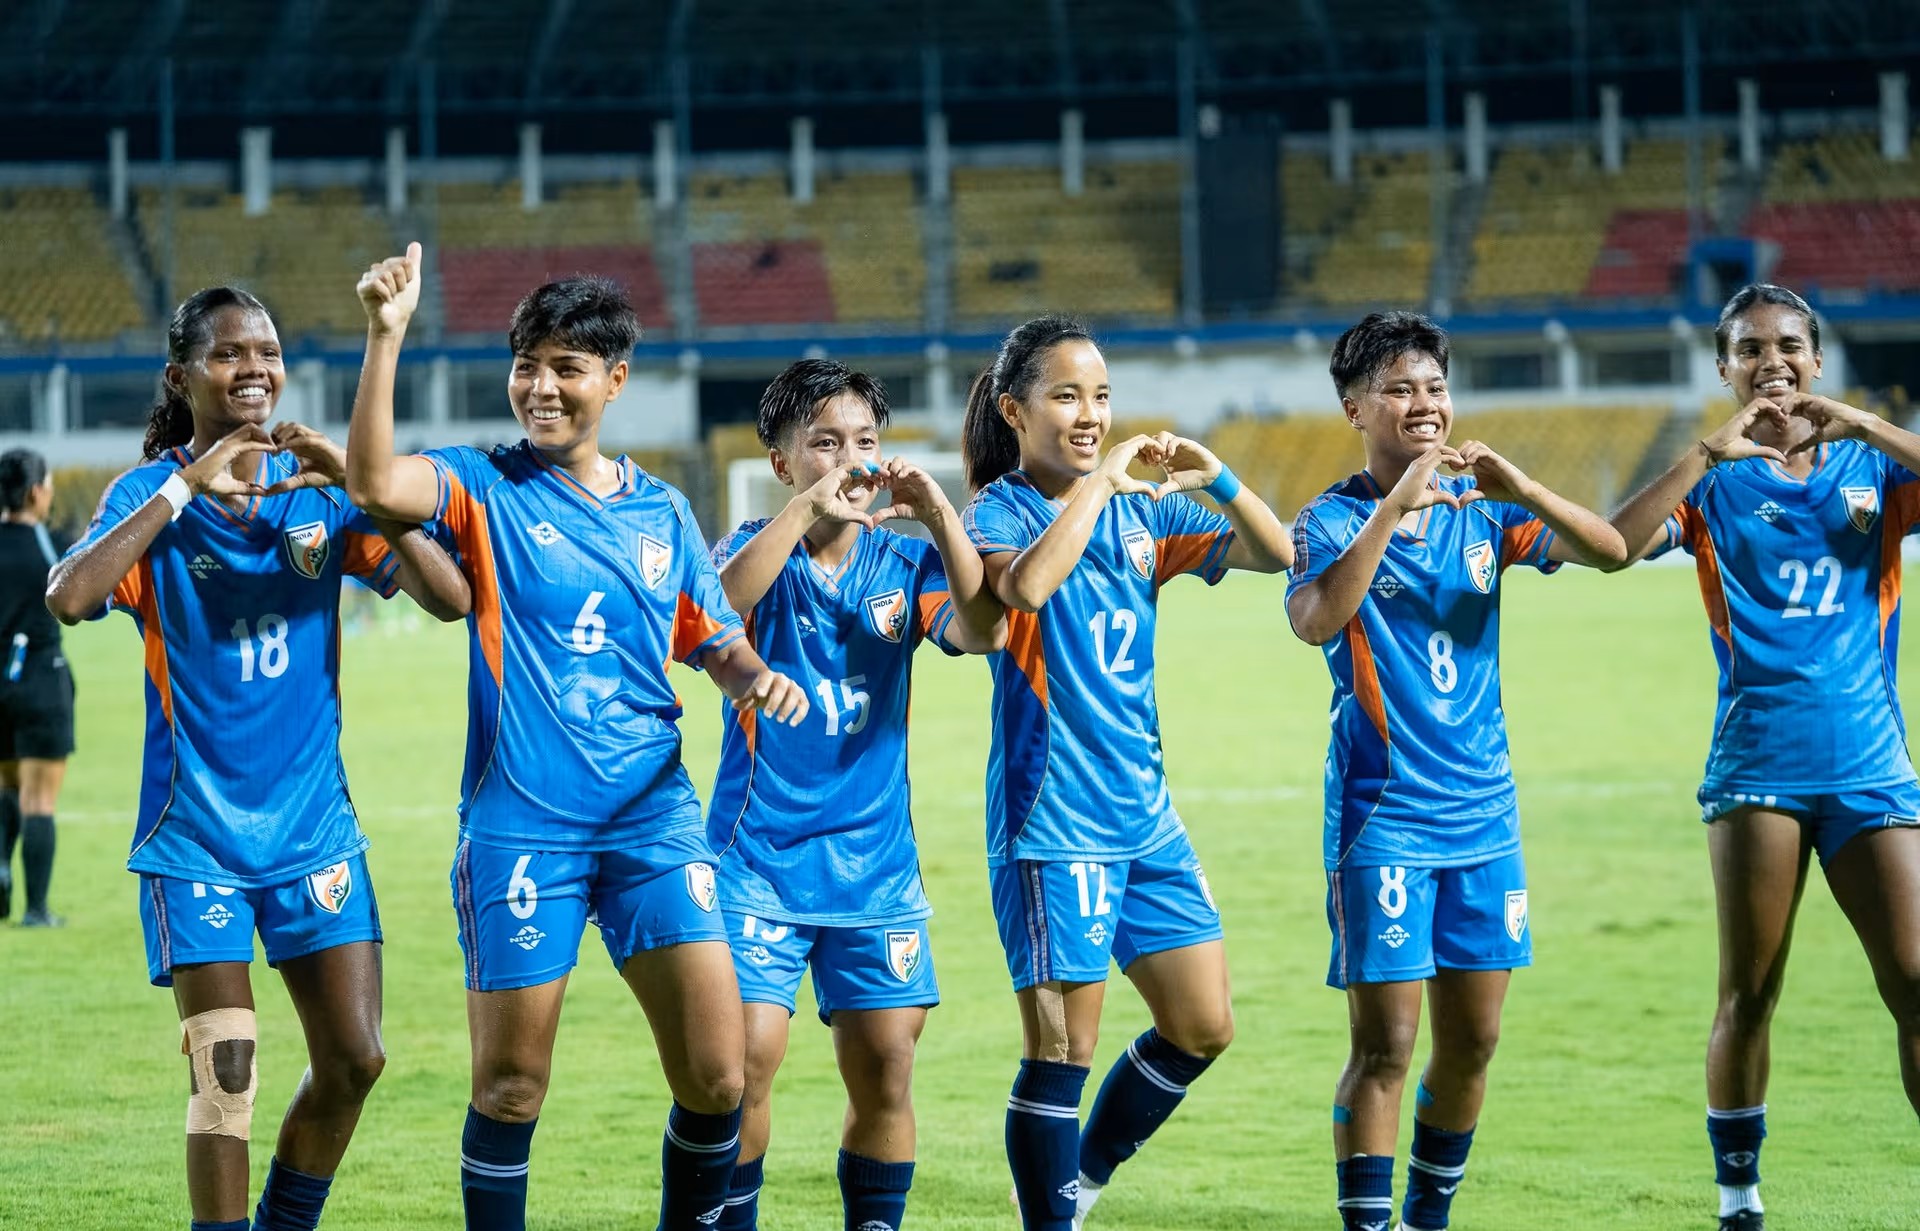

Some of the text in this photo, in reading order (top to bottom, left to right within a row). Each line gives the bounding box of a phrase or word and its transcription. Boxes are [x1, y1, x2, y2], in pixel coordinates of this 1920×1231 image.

[290, 531, 313, 542] INDIA
[872, 598, 894, 609] INDIA
[1779, 556, 1845, 618] 22
[230, 614, 289, 682] 18
[572, 591, 606, 654] 6
[1088, 608, 1137, 675] 12
[1428, 630, 1457, 693] 8
[816, 674, 870, 735] 15
[312, 867, 336, 878] INDIA
[506, 855, 537, 919] 6
[1069, 862, 1110, 917] 12
[1378, 866, 1407, 919] 8
[199, 911, 235, 921] NIVIA
[509, 932, 547, 943] NIVIA
[1378, 932, 1411, 941] NIVIA
